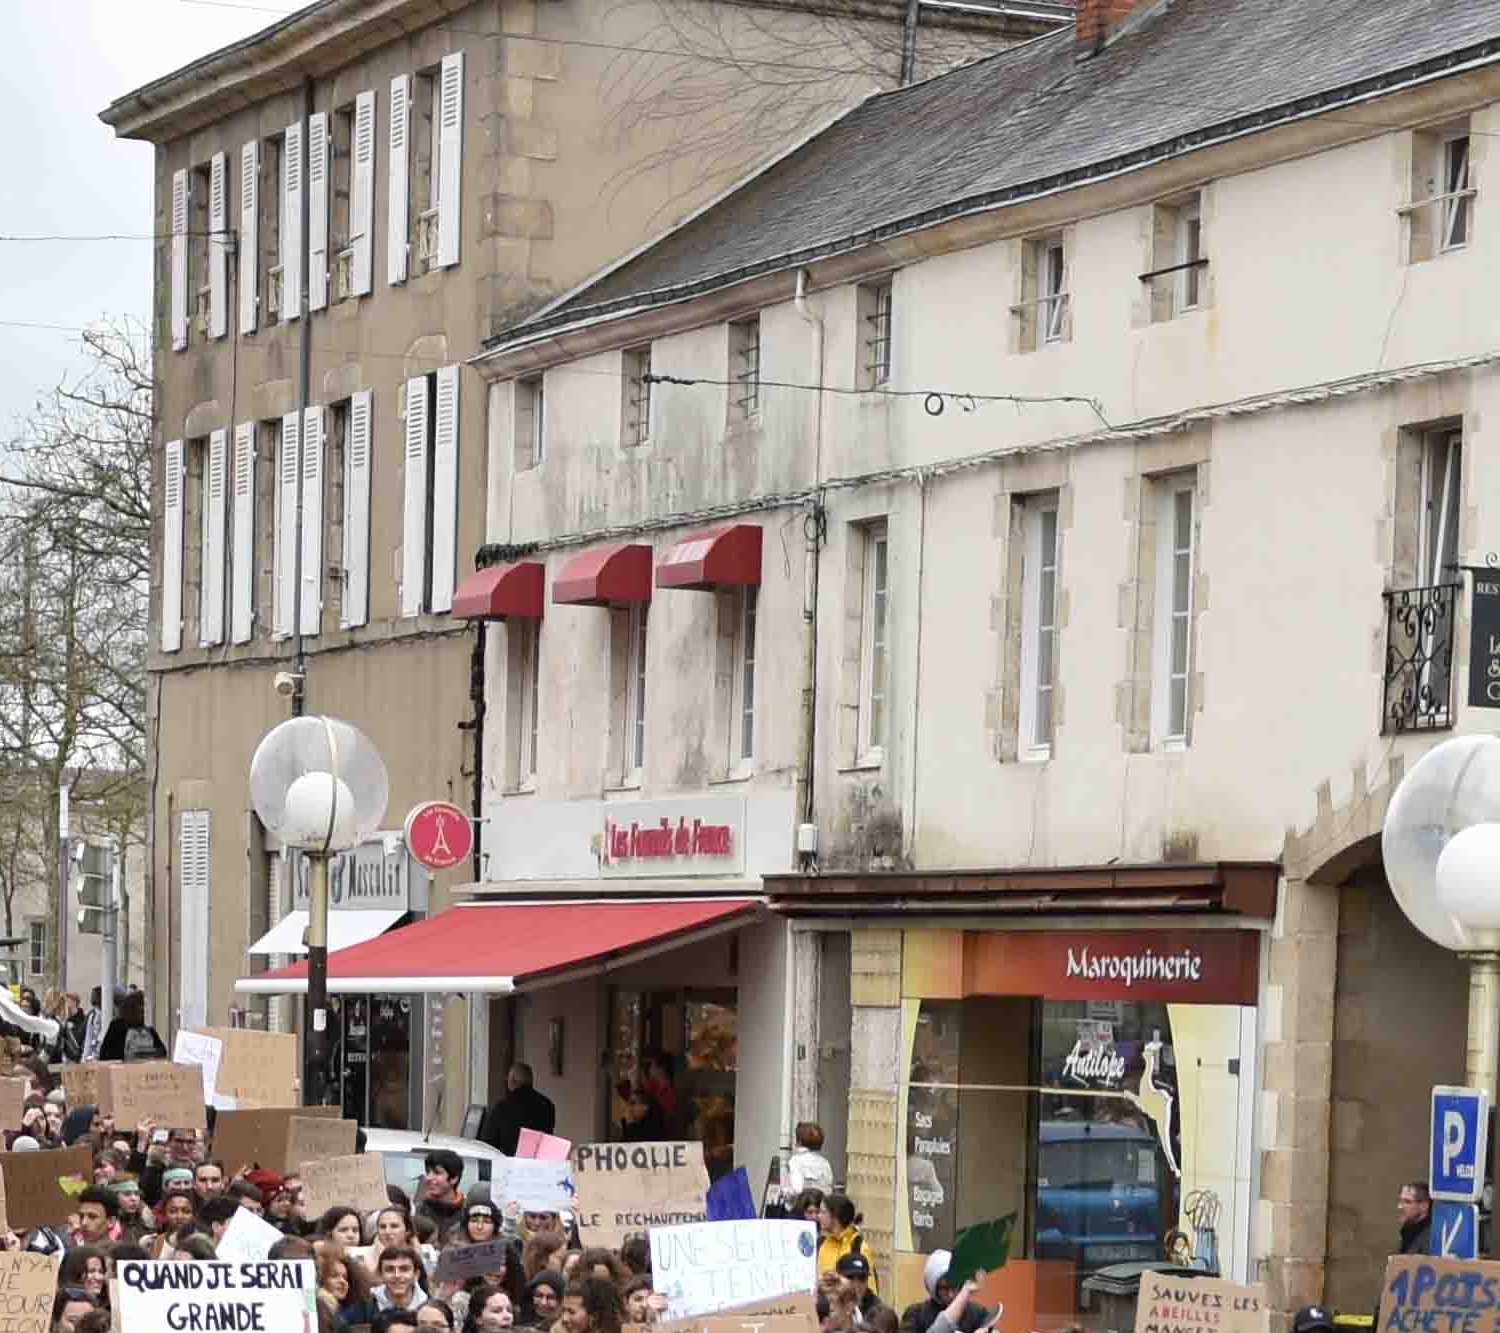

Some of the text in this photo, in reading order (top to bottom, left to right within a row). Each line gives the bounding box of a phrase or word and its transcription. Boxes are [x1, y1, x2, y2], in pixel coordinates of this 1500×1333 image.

[1066, 949, 1201, 987] Maroquinerie
[1062, 1041, 1125, 1086] Antilope
[578, 1145, 688, 1172] PHOQUE
[1443, 1110, 1466, 1177] P
[579, 1214, 602, 1229] LE
[656, 1232, 702, 1272] UNE
[123, 1262, 303, 1293] QUAND JE SERAI
[166, 1302, 266, 1332] GRANDE
[1149, 1304, 1221, 1324] ABEILLES
[1233, 1297, 1260, 1312] LES
